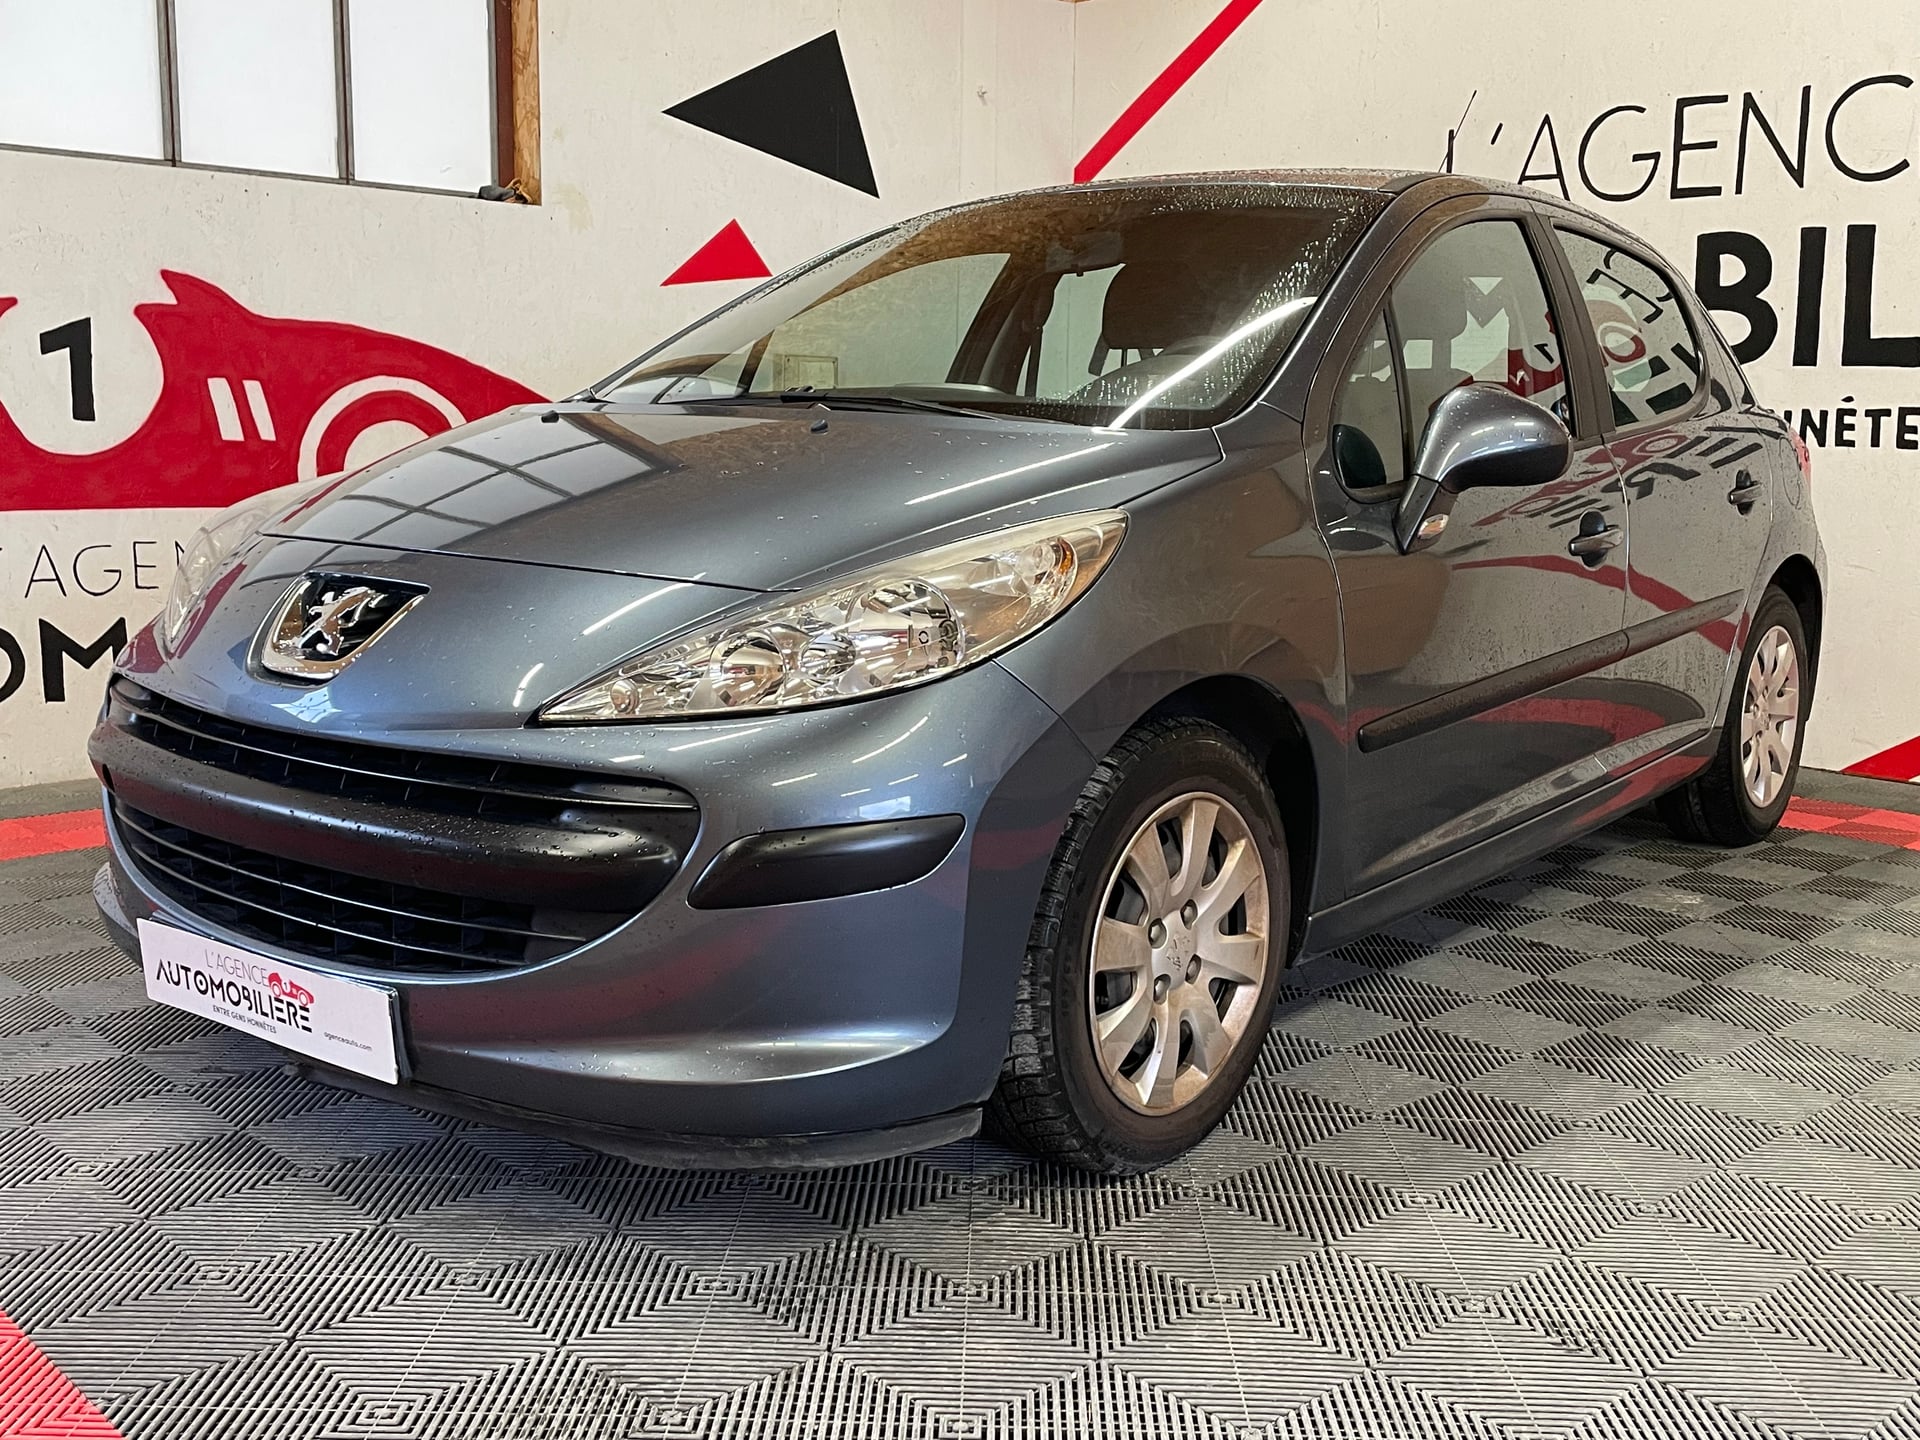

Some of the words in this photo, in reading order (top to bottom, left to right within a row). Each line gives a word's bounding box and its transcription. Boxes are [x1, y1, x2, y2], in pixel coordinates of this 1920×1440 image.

[1694, 224, 1920, 367] BIL
[40, 317, 95, 421] 1
[205, 949, 270, 988] L'AGENCE
[213, 1005, 231, 1018] ENTRE
[231, 1011, 246, 1023] GENS
